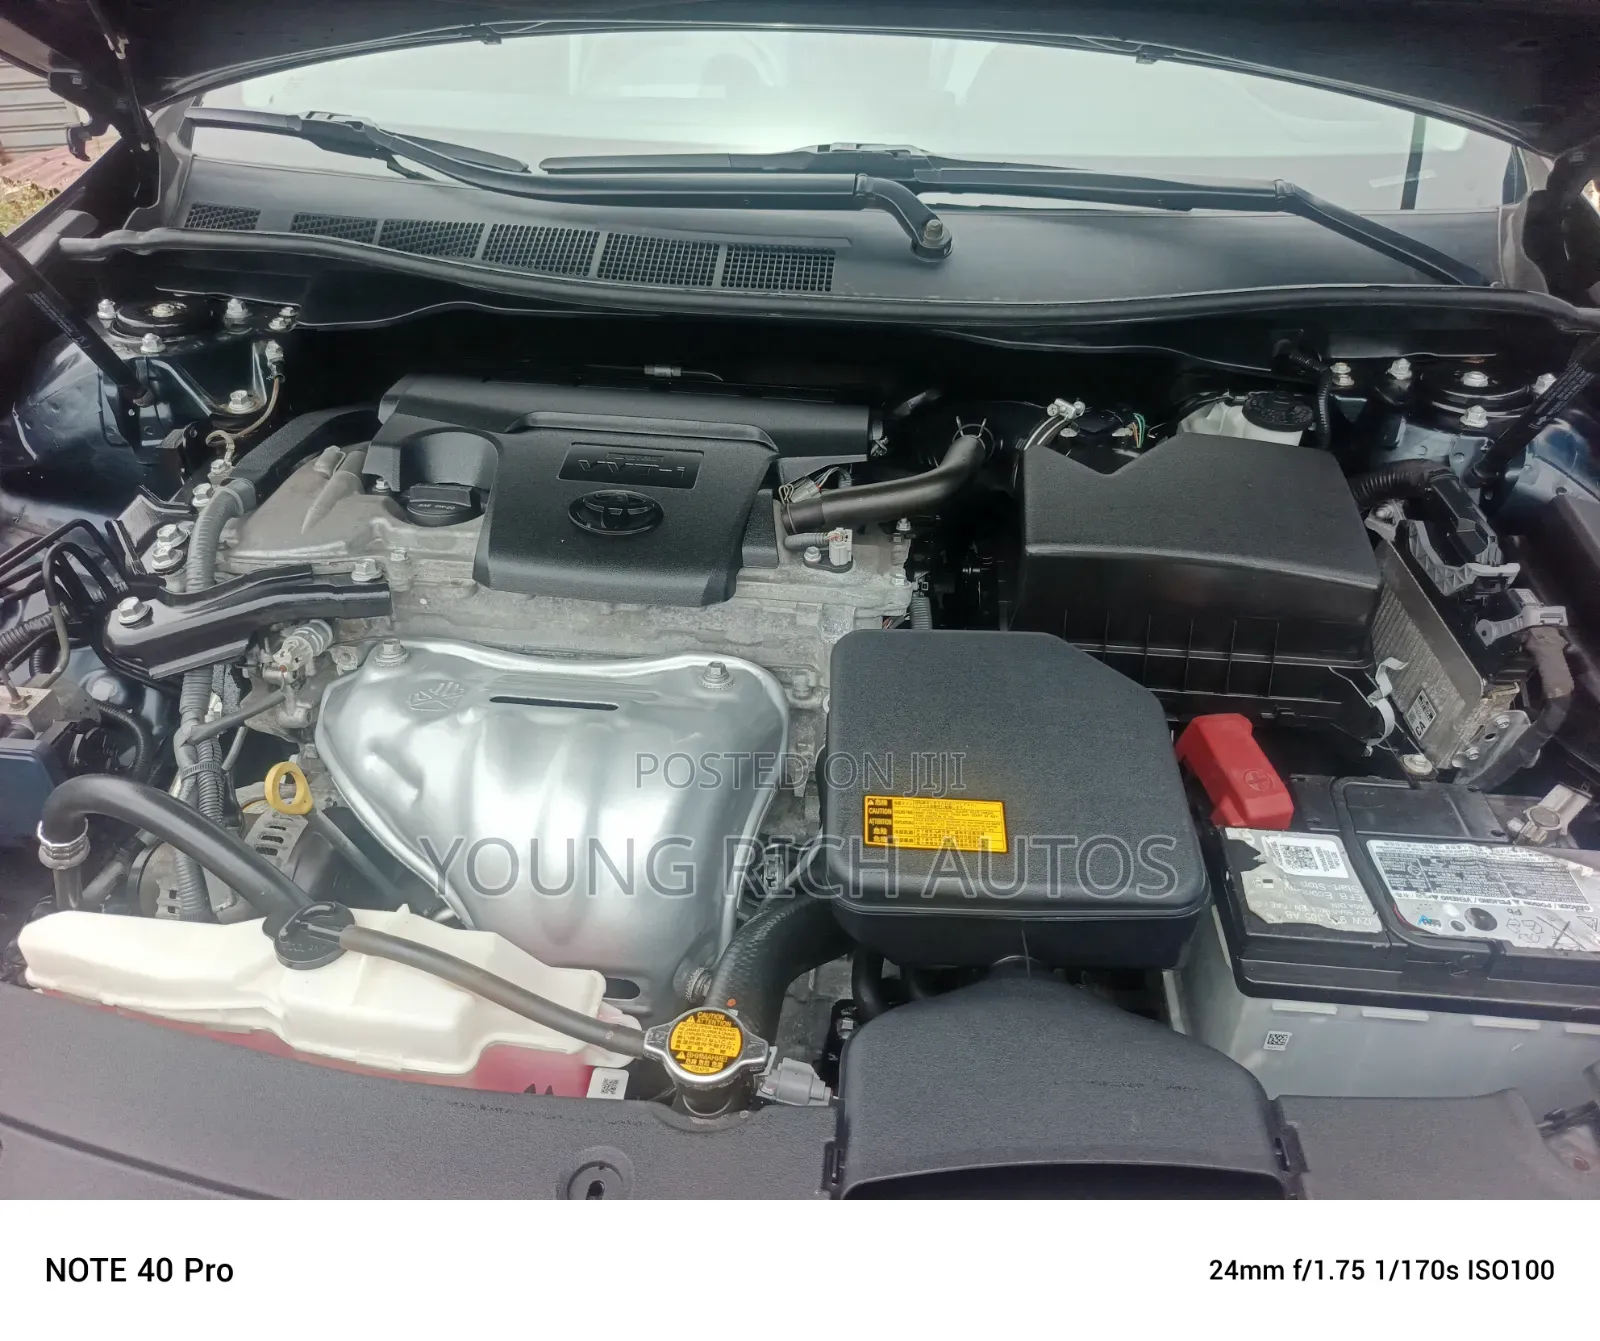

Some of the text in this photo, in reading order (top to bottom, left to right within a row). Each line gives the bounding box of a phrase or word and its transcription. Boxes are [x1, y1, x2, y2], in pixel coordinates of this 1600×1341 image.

[868, 807, 892, 815] CAUTION
[868, 818, 892, 826] ATTENTION
[1506, 907, 1522, 916] Pb
[697, 1012, 725, 1020] CAUTION
[696, 1018, 732, 1028] ATTENTION
